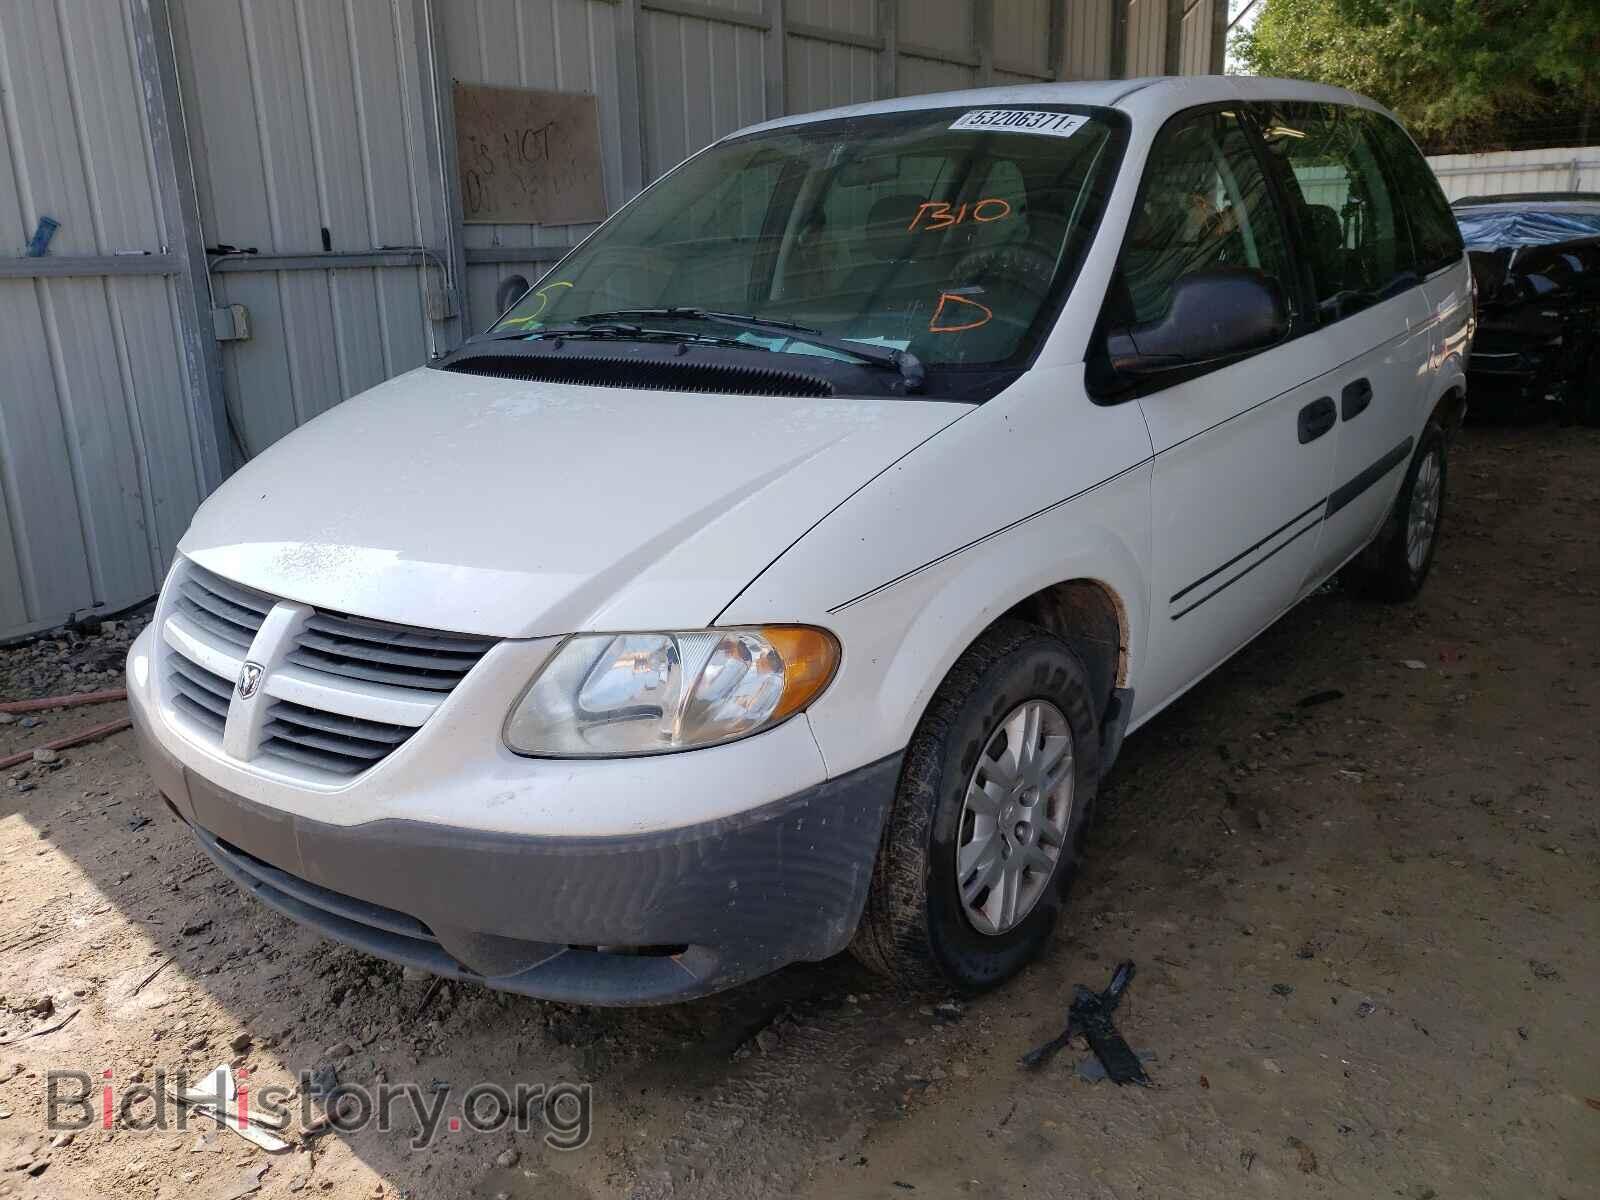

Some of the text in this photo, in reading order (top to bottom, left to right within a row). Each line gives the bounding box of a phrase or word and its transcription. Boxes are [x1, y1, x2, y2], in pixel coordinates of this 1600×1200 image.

[969, 111, 1069, 130] 53206371
[503, 120, 556, 165] NOT
[928, 294, 993, 333] D
